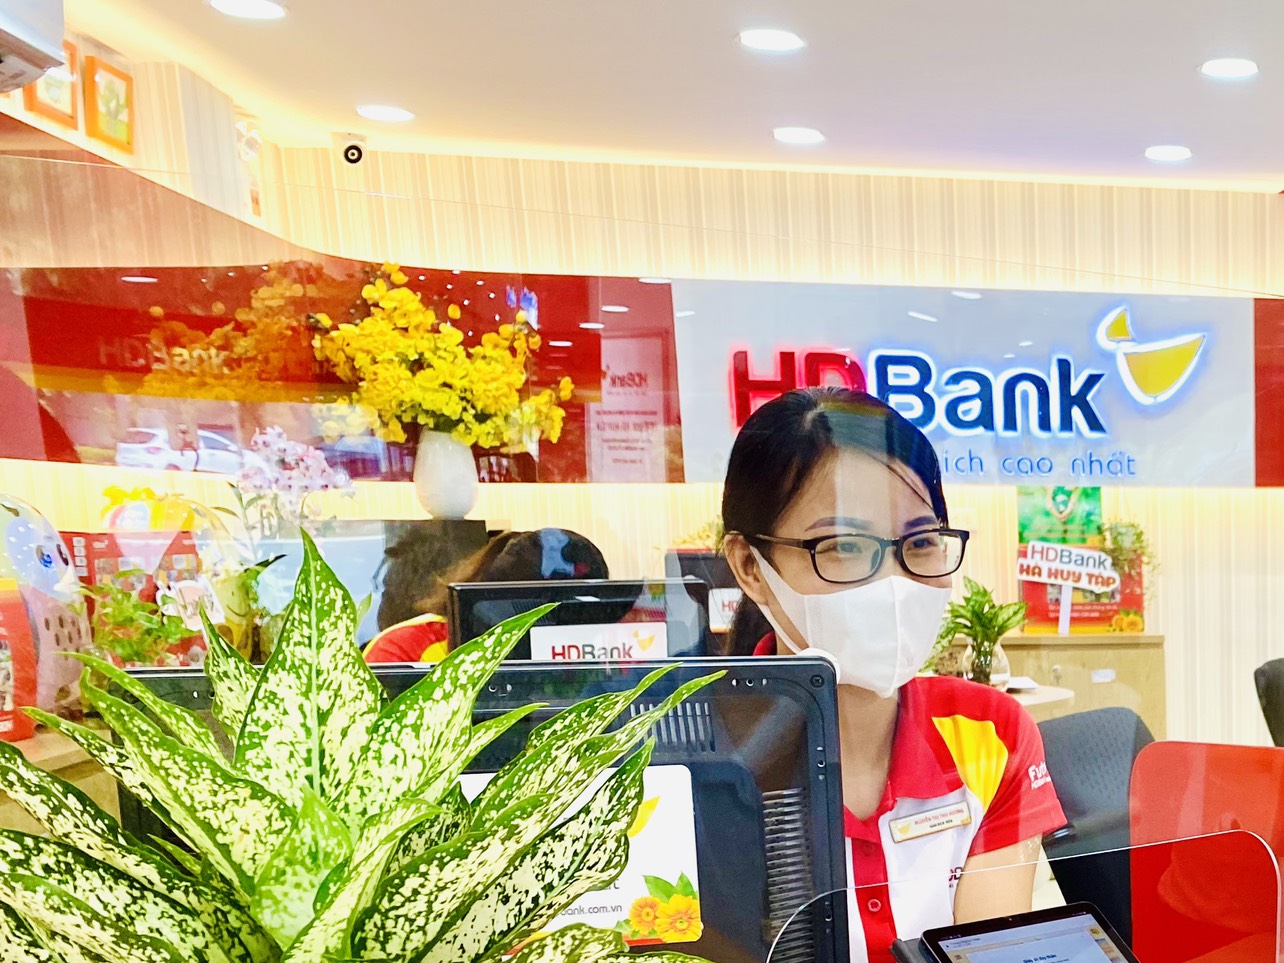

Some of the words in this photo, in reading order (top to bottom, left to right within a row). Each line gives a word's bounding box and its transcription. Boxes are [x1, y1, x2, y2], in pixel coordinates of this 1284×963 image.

[1001, 456, 1054, 476] cao
[1070, 449, 1136, 477] nhất
[1030, 544, 1108, 571] HDBank
[1047, 567, 1082, 583] HUY
